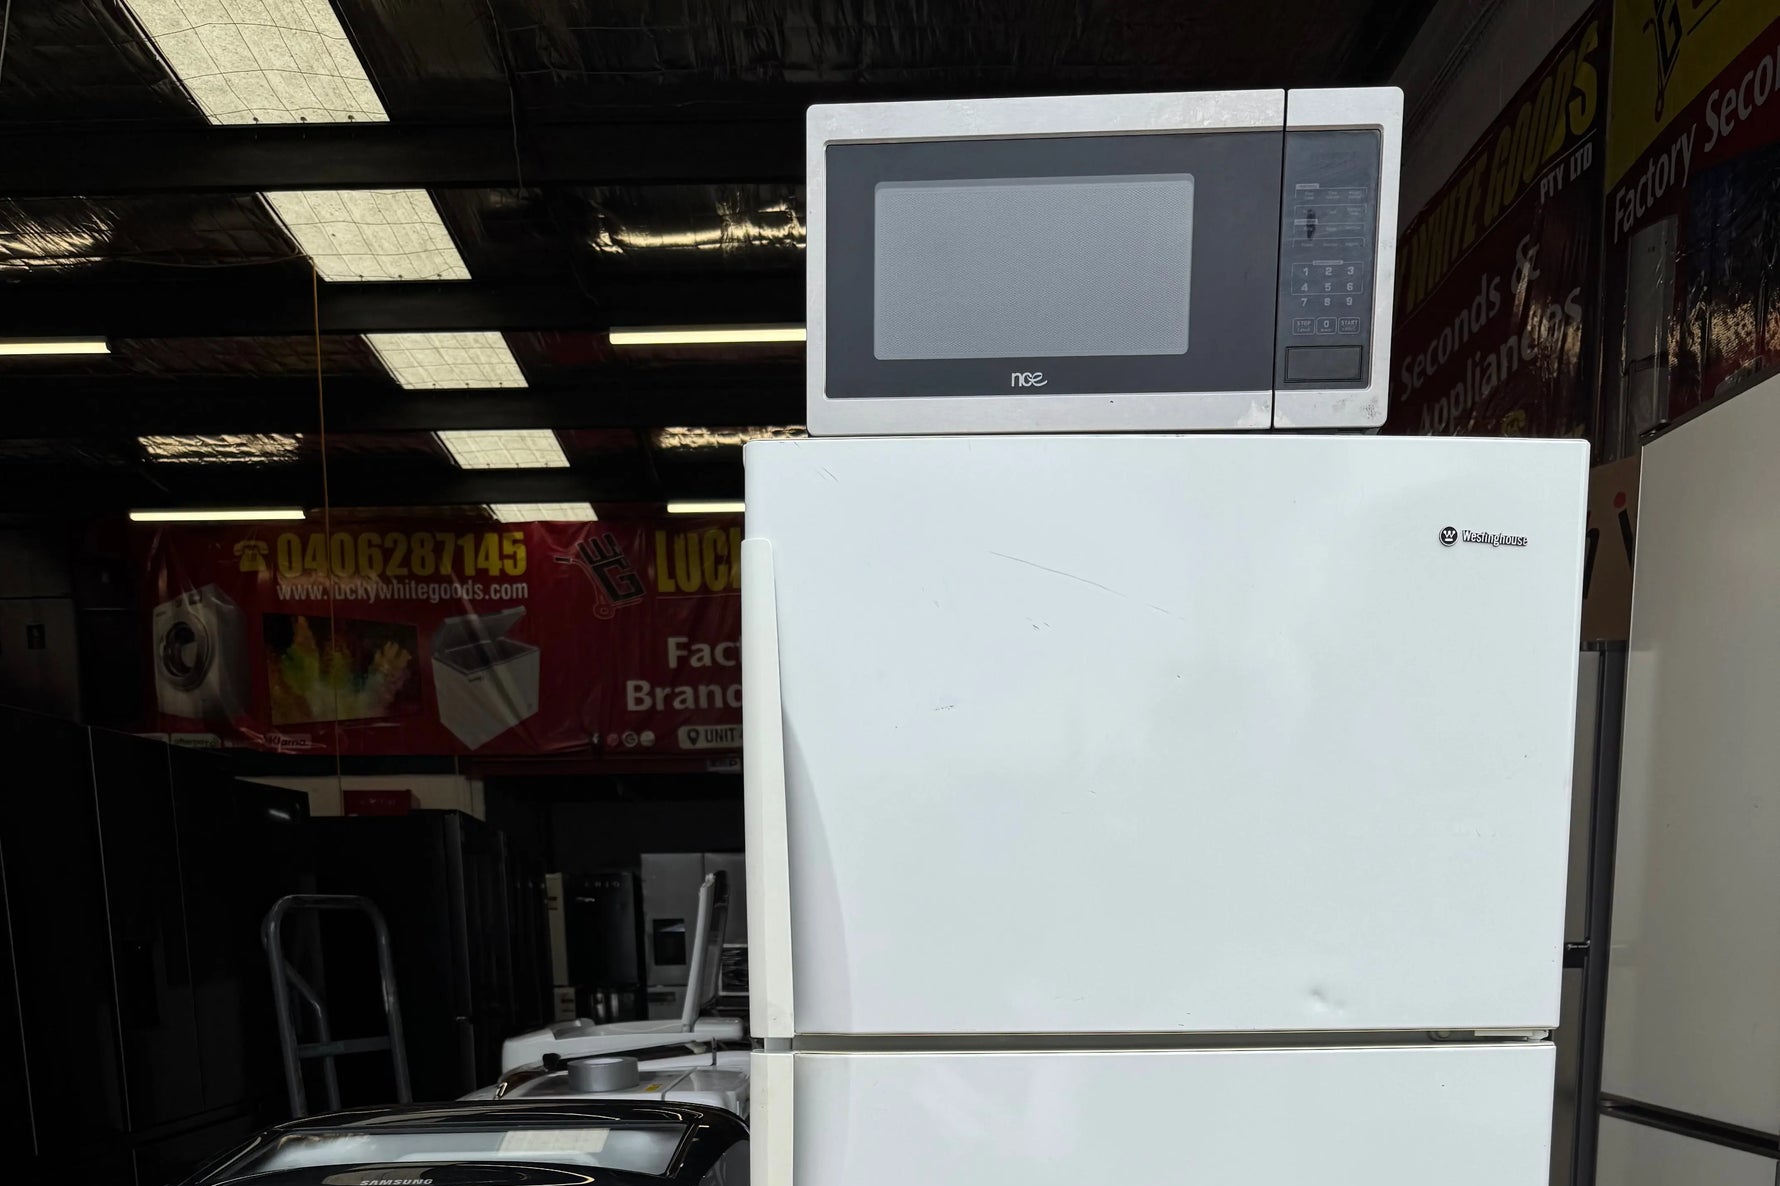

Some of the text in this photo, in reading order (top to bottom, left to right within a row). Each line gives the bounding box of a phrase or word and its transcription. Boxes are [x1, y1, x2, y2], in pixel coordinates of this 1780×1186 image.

[1484, 20, 1598, 227] GOODS
[1613, 44, 1780, 243] Factory Seco
[1540, 141, 1593, 204] PTY LTD
[1401, 271, 1501, 401] Seconds
[276, 531, 527, 578] 0406287145
[1462, 529, 1529, 548] Westinghouse
[667, 636, 741, 669] Fac
[705, 727, 737, 744] UNIT
